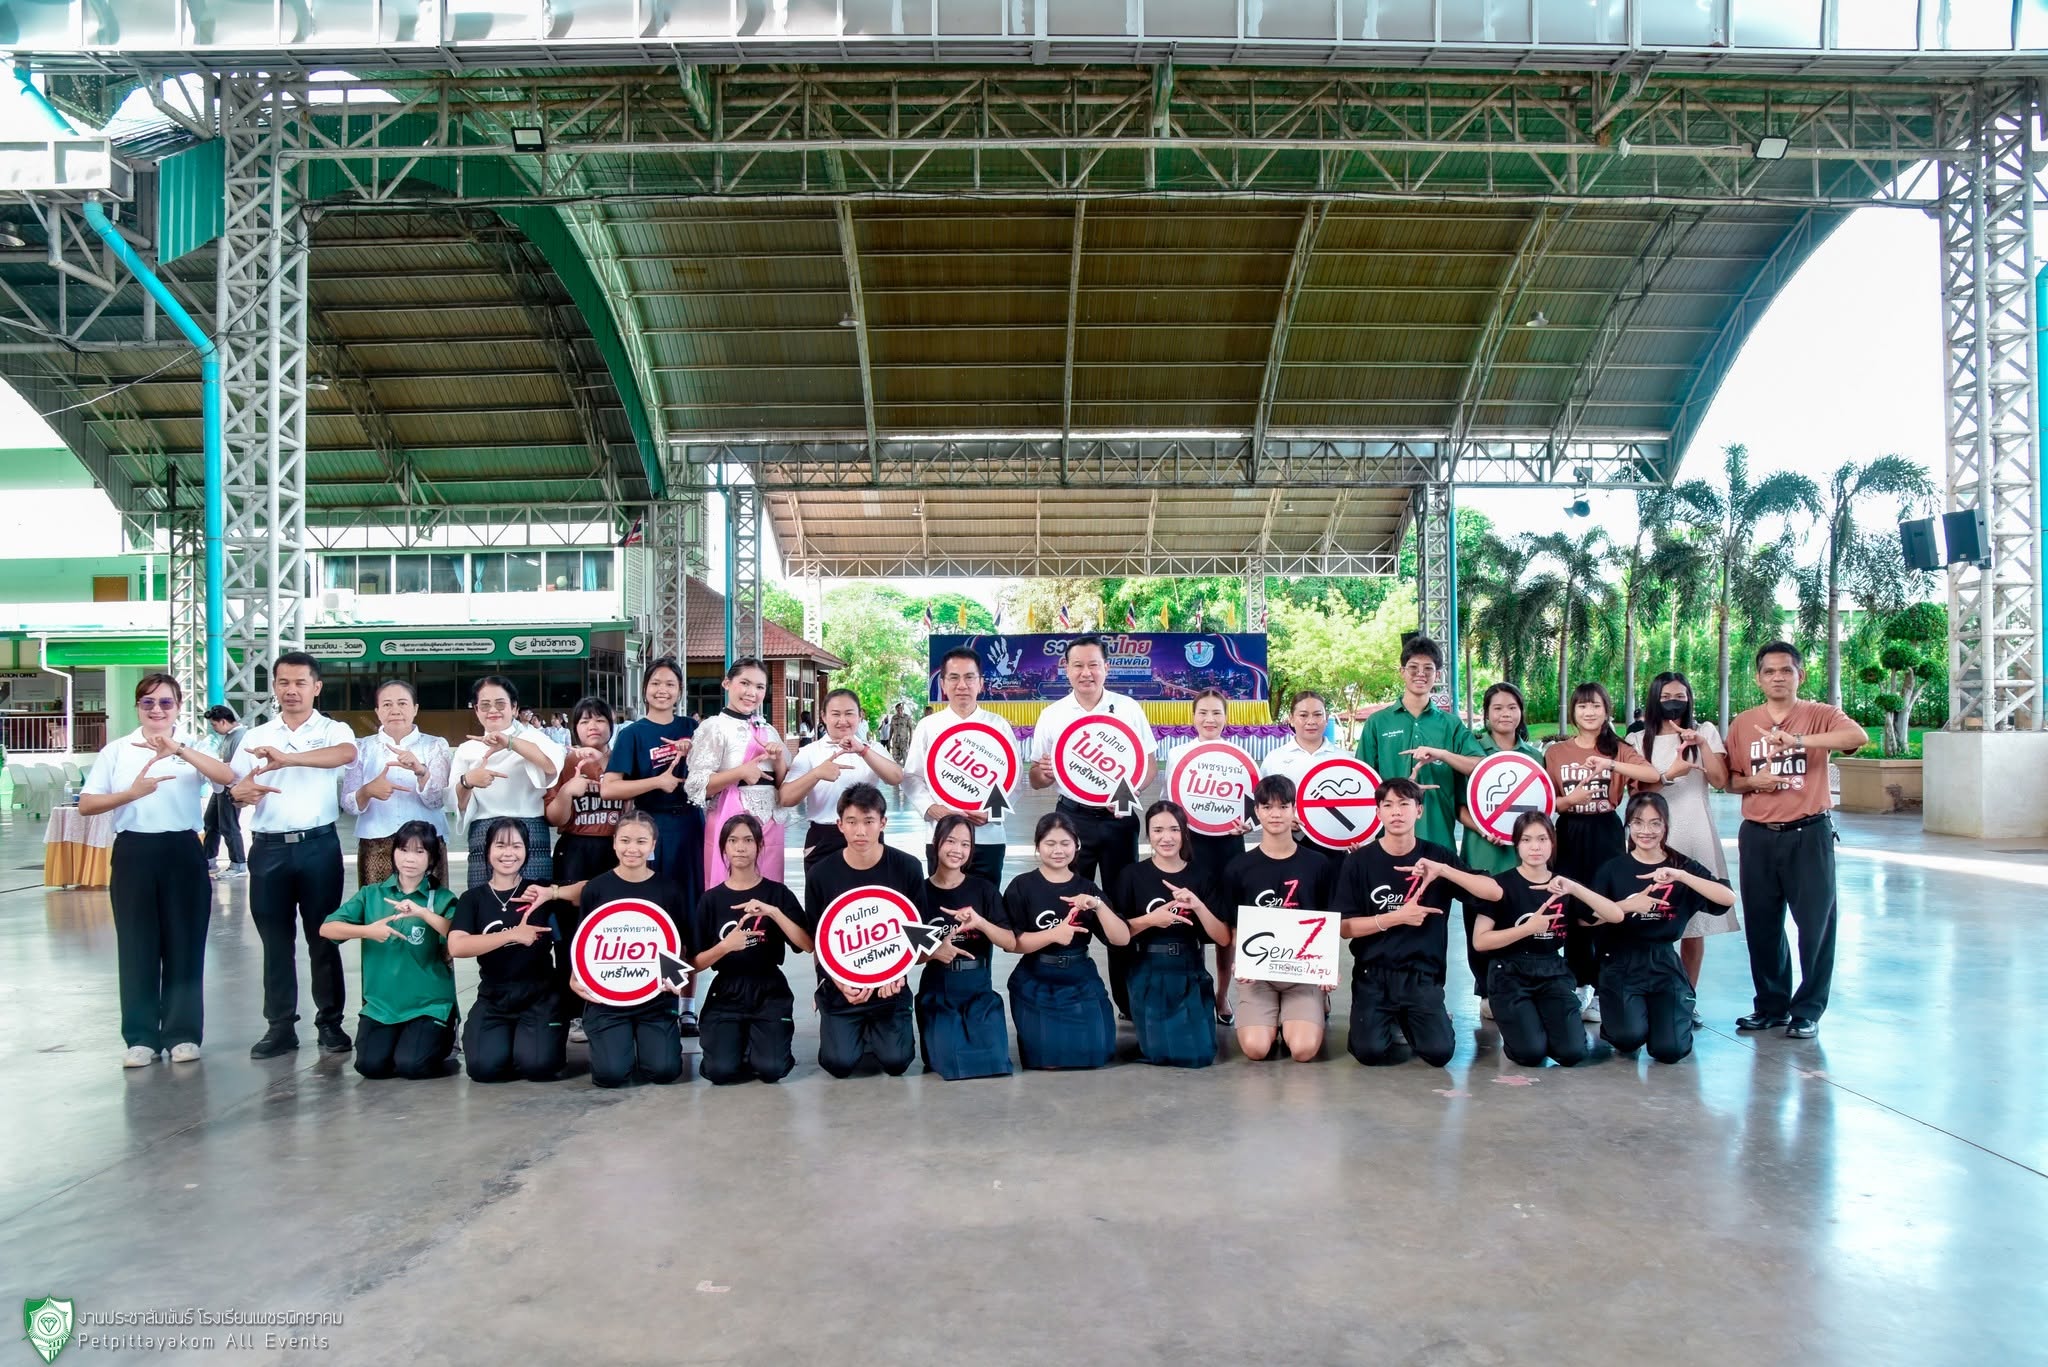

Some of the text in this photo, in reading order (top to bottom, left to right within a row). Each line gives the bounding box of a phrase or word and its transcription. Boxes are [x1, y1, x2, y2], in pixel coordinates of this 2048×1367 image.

[530, 638, 577, 647] ฝ่ายวิชาการ
[963, 736, 1006, 767] เพชรพิทยาคม
[1072, 730, 1126, 780] ไม่เอา
[1096, 731, 1127, 753] คนไทย
[944, 738, 998, 787] ไม่เอา
[1068, 760, 1108, 790] บุหรี่ไฟฟ้า
[1197, 762, 1244, 776] เพชรบูรณ์
[941, 769, 980, 797] บุหรี่ไฟฟ้า
[1186, 769, 1244, 800] ไม่เอา
[1191, 801, 1235, 815] บุหรี่ไฟฟ้า
[1283, 879, 1299, 908] Z
[1371, 884, 1404, 910] Gen
[845, 905, 879, 924] คนไทย
[603, 924, 658, 934] เพชรพิทยาคม
[834, 917, 900, 954] ไม่เอา
[1241, 916, 1326, 966] Gen Z
[593, 934, 658, 960] ไม่เอา
[853, 943, 901, 969] บุหรี่ไฟฟ้า
[600, 965, 650, 981] บุหรี่ไฟฟ้า
